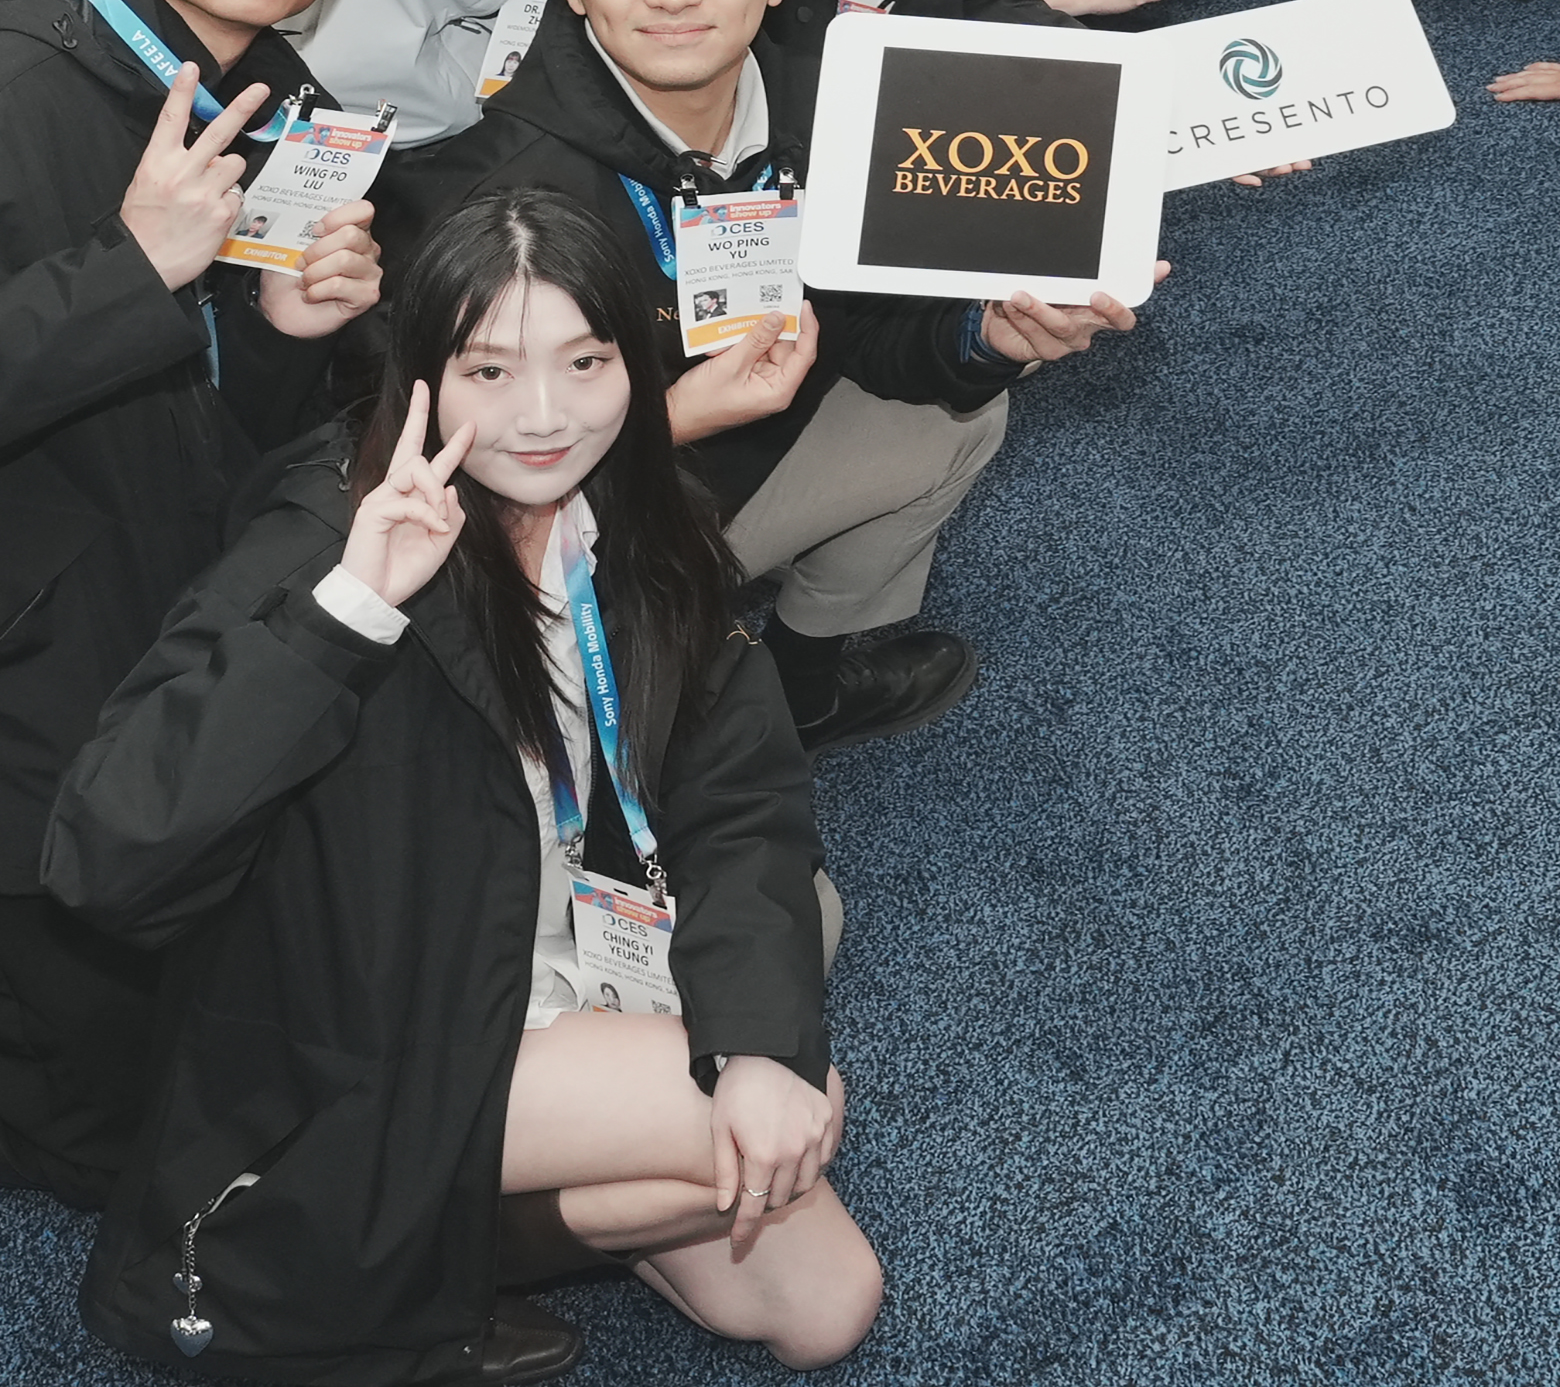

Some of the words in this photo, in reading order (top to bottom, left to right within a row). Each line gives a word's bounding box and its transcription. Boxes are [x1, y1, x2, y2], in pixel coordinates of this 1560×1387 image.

[897, 127, 1089, 180] XOXO
[892, 171, 1081, 205] BEVERAGES
[708, 239, 735, 252] WO
[738, 236, 770, 249] PING
[728, 247, 747, 259] YU
